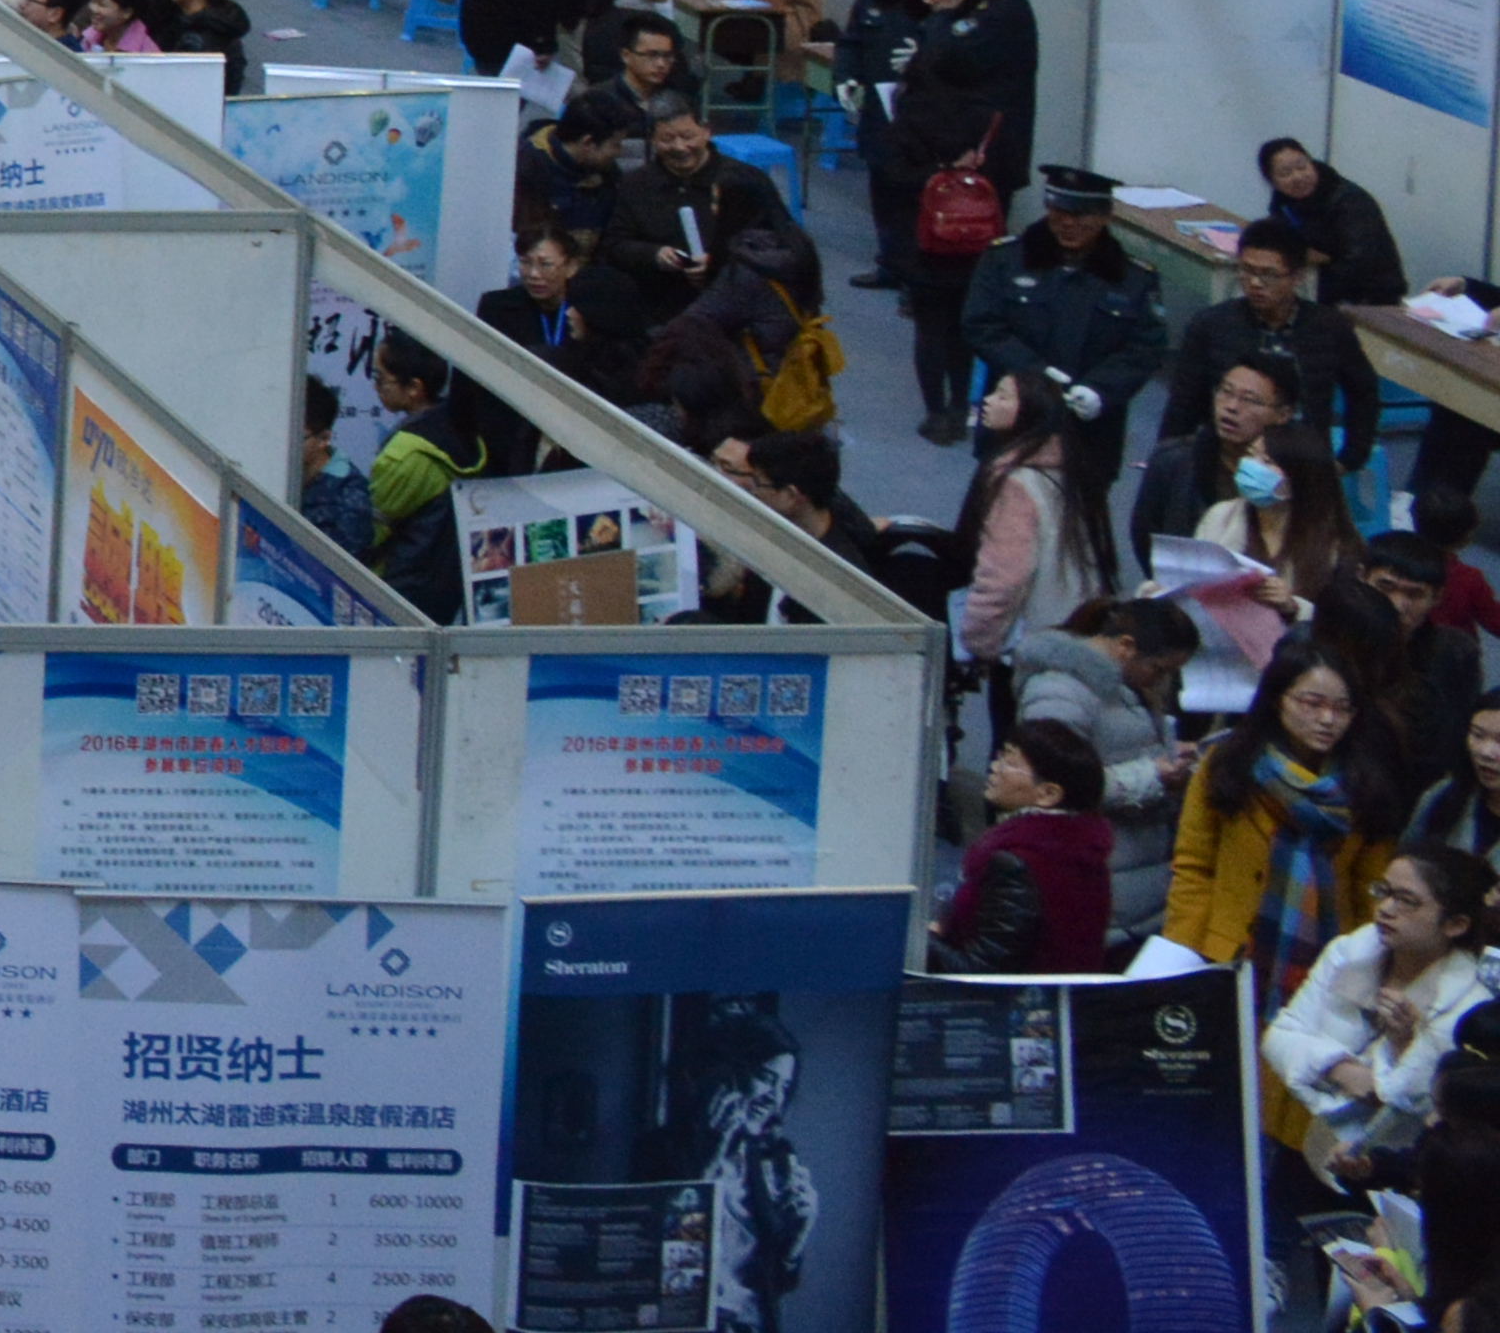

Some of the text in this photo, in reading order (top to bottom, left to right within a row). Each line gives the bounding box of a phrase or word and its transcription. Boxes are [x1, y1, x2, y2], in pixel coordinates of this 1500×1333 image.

[43, 118, 104, 134] LANDISO
[544, 958, 629, 975] Sheraton
[326, 983, 463, 1000] LANDISON
[122, 1032, 325, 1083] 招贤纳士
[122, 1099, 456, 1130] 湖州太湖雷迪森温泉度假酒店
[126, 1148, 161, 1166] 部门
[193, 1151, 260, 1169] 职务名称
[301, 1150, 368, 1168] 招聘人数
[126, 1191, 176, 1208] 工程部
[329, 1193, 337, 1207] 1
[369, 1194, 463, 1210] 6000-10000
[126, 1231, 176, 1248] 工程部
[328, 1233, 337, 1247] 2
[374, 1233, 458, 1248] 3500-5500
[126, 1270, 176, 1288] 工程部
[327, 1271, 337, 1284] 4
[372, 1272, 456, 1286] 2500-3800
[327, 1310, 336, 1324] 2
